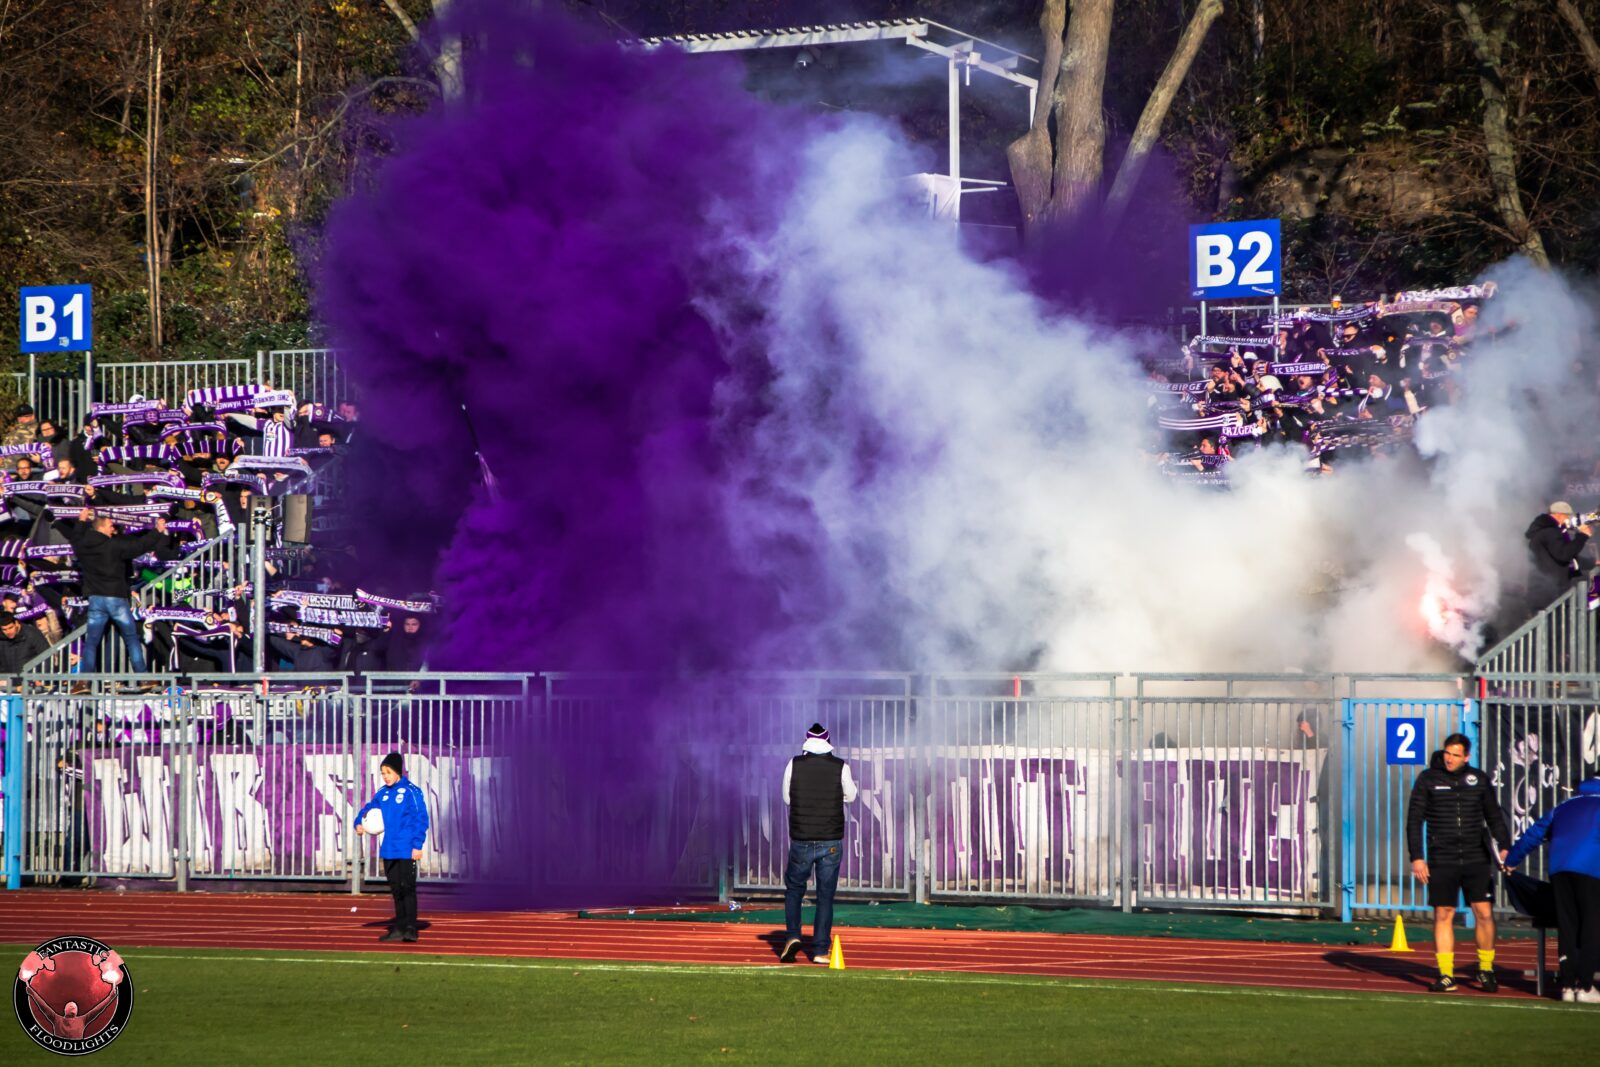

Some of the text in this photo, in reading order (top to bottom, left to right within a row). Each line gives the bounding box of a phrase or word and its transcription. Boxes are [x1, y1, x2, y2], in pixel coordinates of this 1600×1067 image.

[1196, 230, 1274, 288] B2
[25, 293, 84, 342] B1
[1396, 722, 1416, 759] 2
